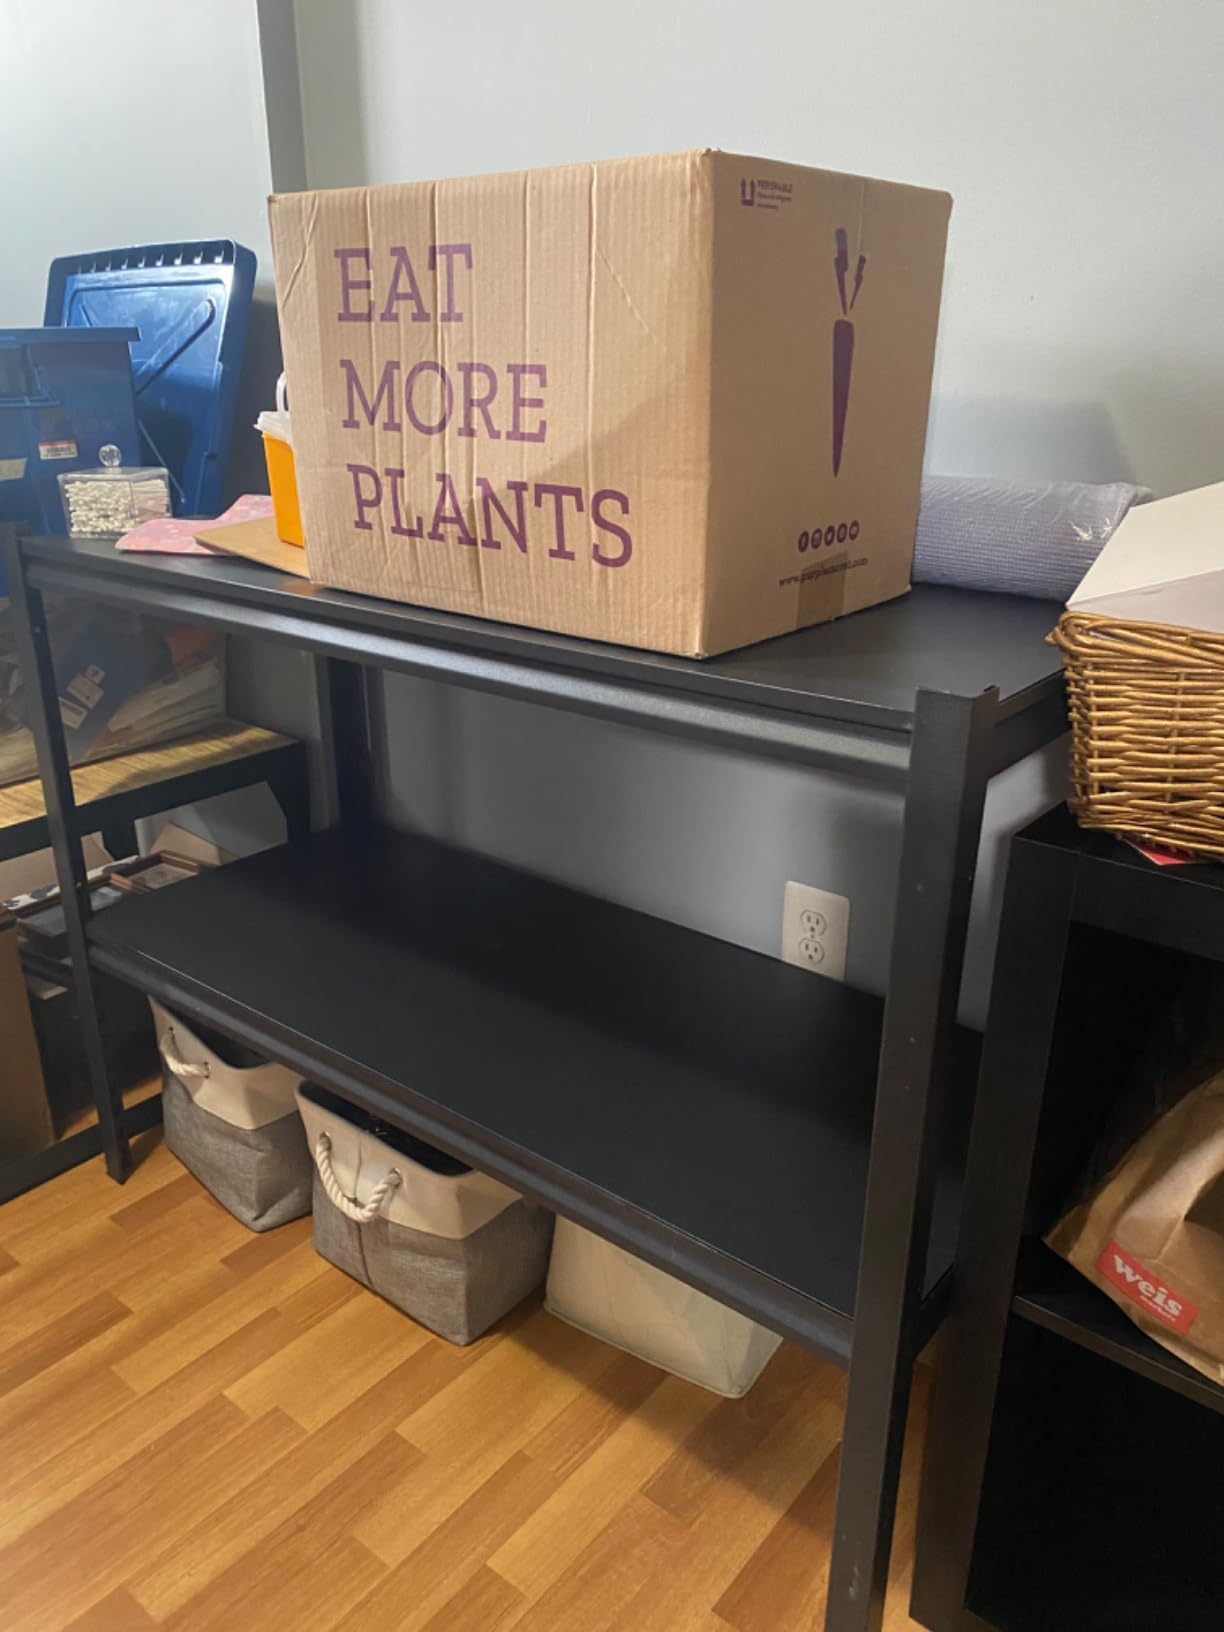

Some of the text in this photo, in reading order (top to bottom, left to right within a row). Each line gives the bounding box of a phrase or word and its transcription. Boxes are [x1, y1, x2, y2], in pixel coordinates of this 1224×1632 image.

[334, 243, 473, 322] EAT
[339, 359, 547, 443] MORE
[346, 463, 633, 568] PLANTS
